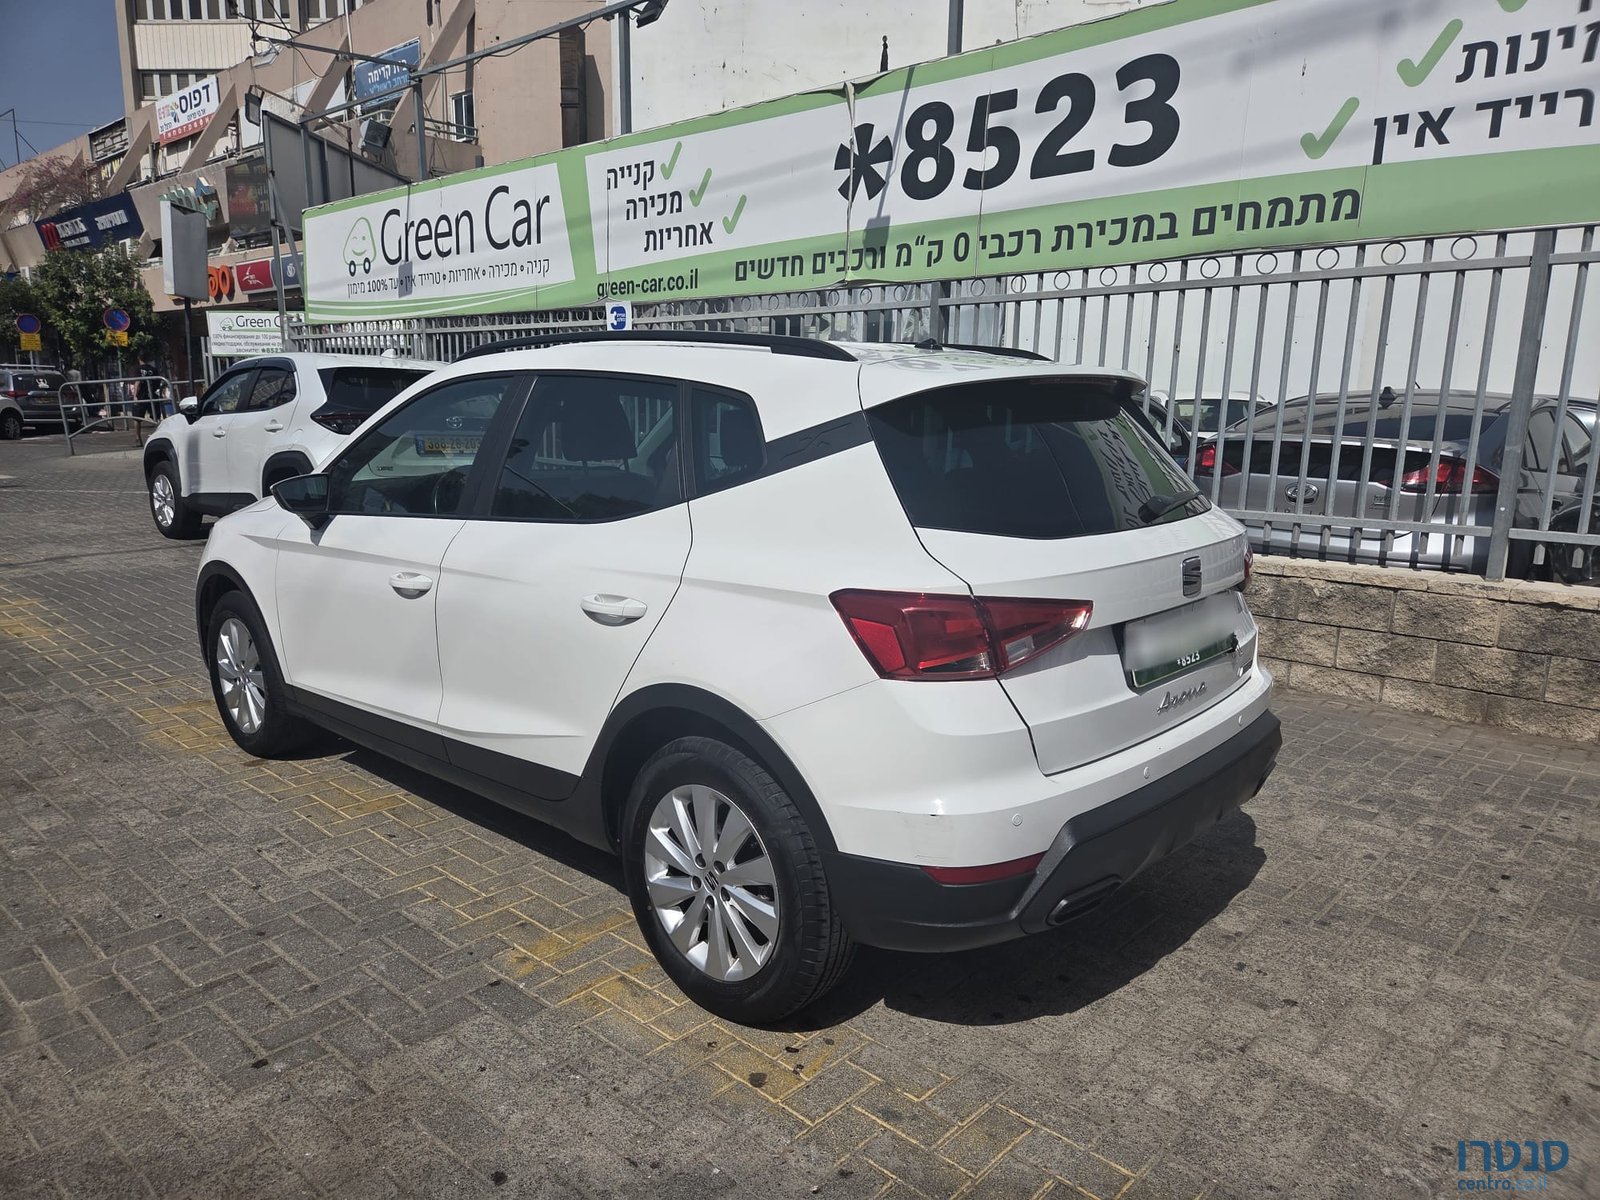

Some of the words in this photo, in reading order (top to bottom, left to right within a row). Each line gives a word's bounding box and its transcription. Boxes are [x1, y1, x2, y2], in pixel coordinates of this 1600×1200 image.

[178, 83, 210, 114] דפוס
[1372, 106, 1456, 165] אין
[607, 160, 655, 191] קנייה
[626, 190, 683, 221] מכירה
[1192, 188, 1361, 237] מתמחים
[381, 208, 475, 266] Green
[484, 185, 550, 251] Car
[644, 221, 714, 252] אחריות
[1050, 211, 1179, 253] במכירת
[953, 232, 970, 262] 0
[979, 228, 1042, 260] רכבי
[448, 265, 481, 284] אחריות
[488, 262, 518, 279] מכירה
[526, 258, 550, 278] קניה
[735, 255, 804, 282] חדשים
[812, 245, 886, 275] ורכבים
[347, 281, 366, 298] מימון
[367, 278, 388, 293] 100%
[388, 277, 399, 291] עד
[404, 275, 416, 292] אין
[418, 272, 441, 287] טרייד
[597, 268, 698, 299] green-car.co.il
[235, 315, 272, 328] Green
